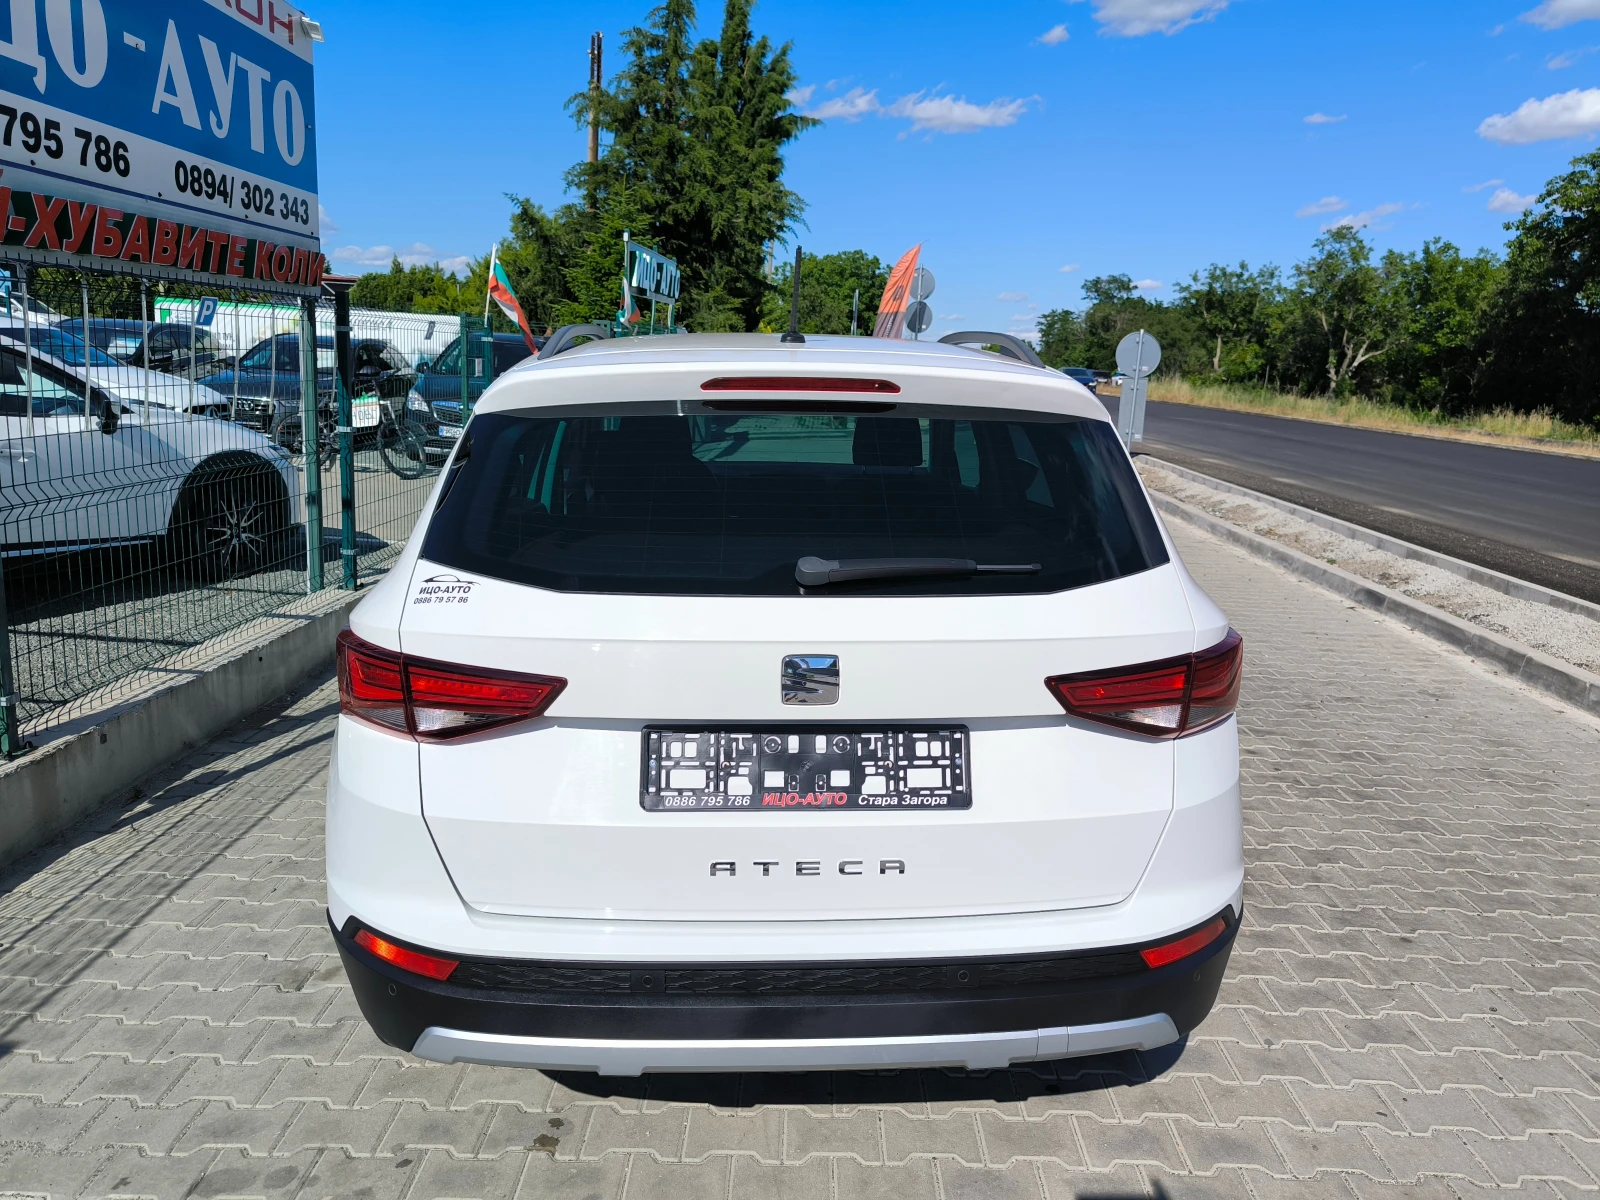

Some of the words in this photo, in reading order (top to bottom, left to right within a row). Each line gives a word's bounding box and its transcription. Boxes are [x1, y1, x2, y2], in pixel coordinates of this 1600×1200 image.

[74, 127, 131, 178] 786
[174, 160, 235, 209] 0894/
[240, 180, 275, 217] 302
[280, 193, 310, 226] 343
[254, 239, 325, 287] КОЛИ
[418, 585, 472, 596] ИЦО-АУТО
[413, 596, 432, 605] 0886
[434, 596, 444, 604] 79
[445, 596, 457, 604] 57
[457, 596, 469, 604] 86
[665, 796, 697, 807] 0886
[700, 796, 724, 807] 795
[727, 796, 751, 807] 786
[761, 792, 848, 808] ИЦО-АУТО
[858, 794, 898, 807] Стара
[901, 794, 948, 807] Загора
[709, 859, 906, 877] ATECA
